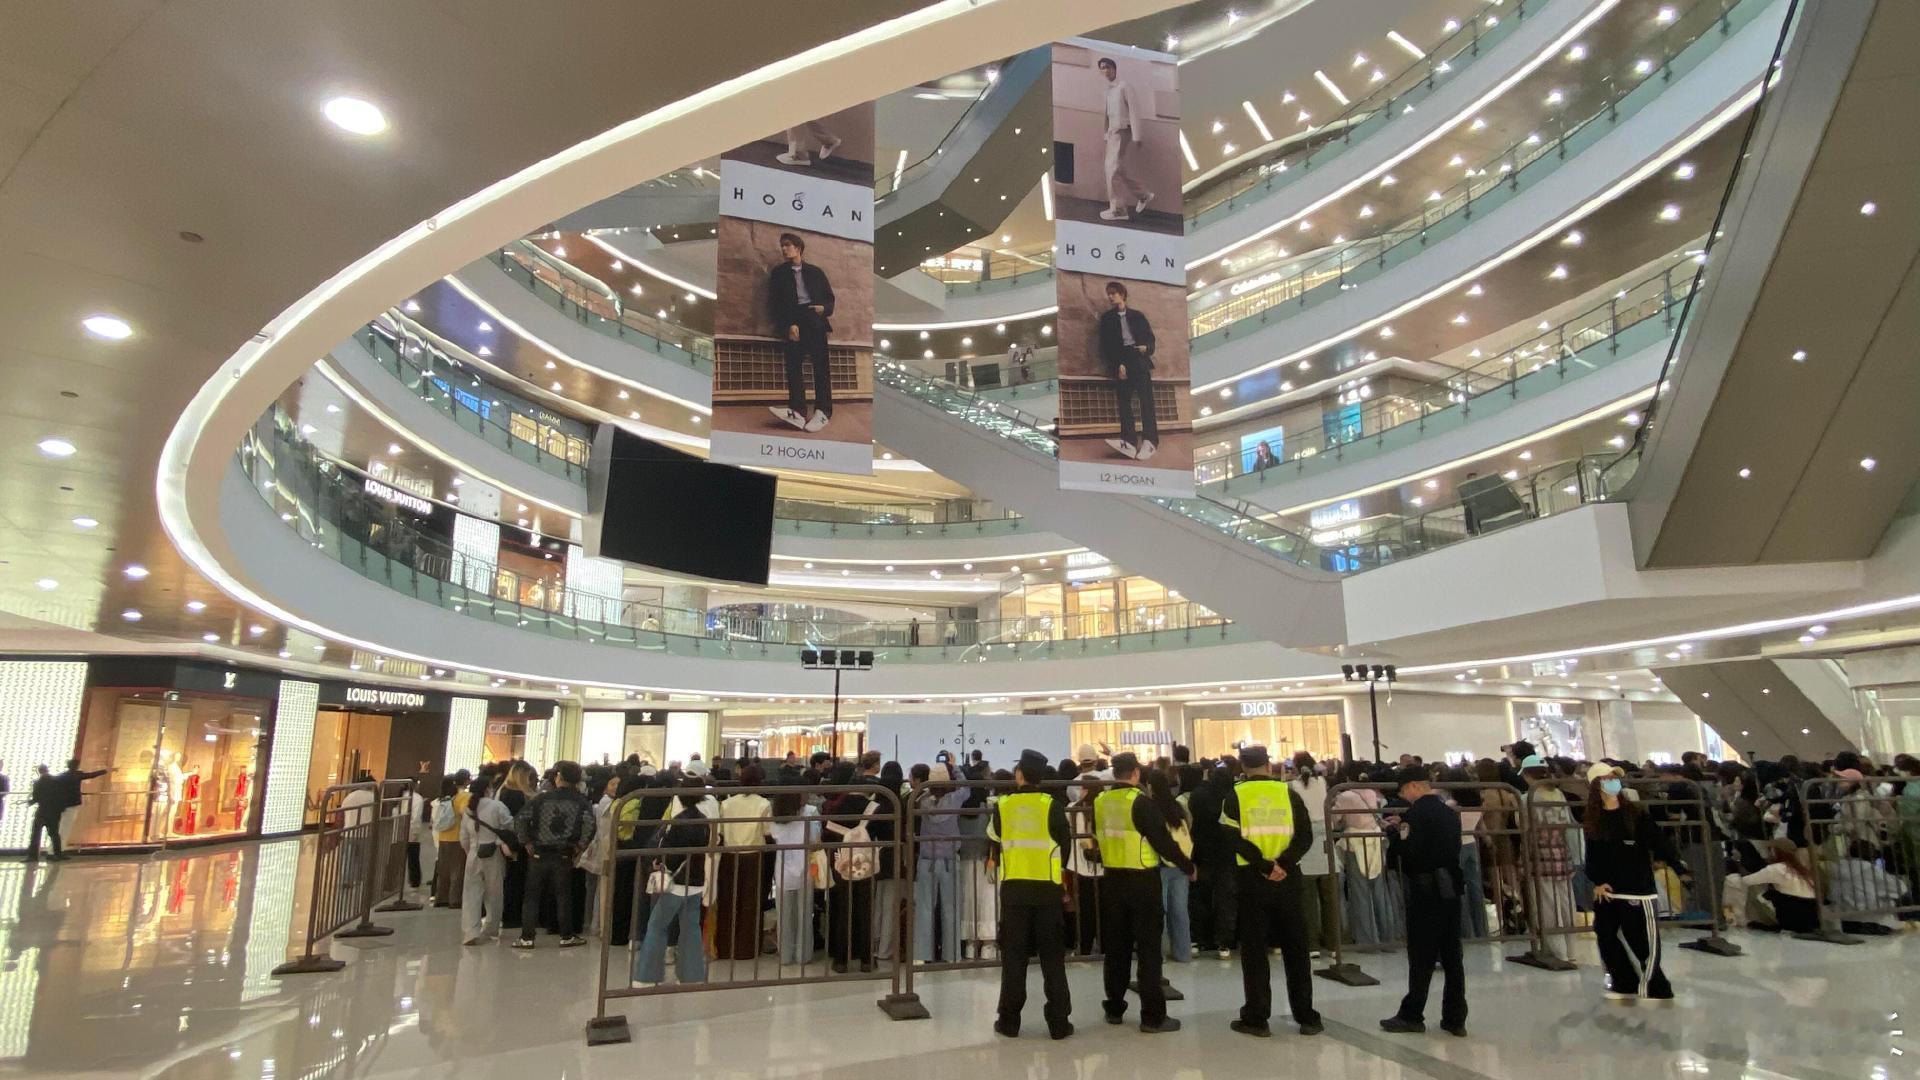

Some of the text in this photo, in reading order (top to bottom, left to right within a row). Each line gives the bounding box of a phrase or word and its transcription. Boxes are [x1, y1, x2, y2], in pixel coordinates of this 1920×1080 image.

[733, 187, 862, 222] HOGAN
[1066, 243, 1175, 269] HOGAN
[760, 444, 825, 460] L2 HOGAN
[1100, 473, 1155, 486] L2 HOGAN
[364, 479, 433, 514] LOUIS VUITTON
[346, 687, 425, 707] LOUIS VUITTON
[1093, 707, 1121, 721] DIOR
[1240, 701, 1277, 716] DIOR
